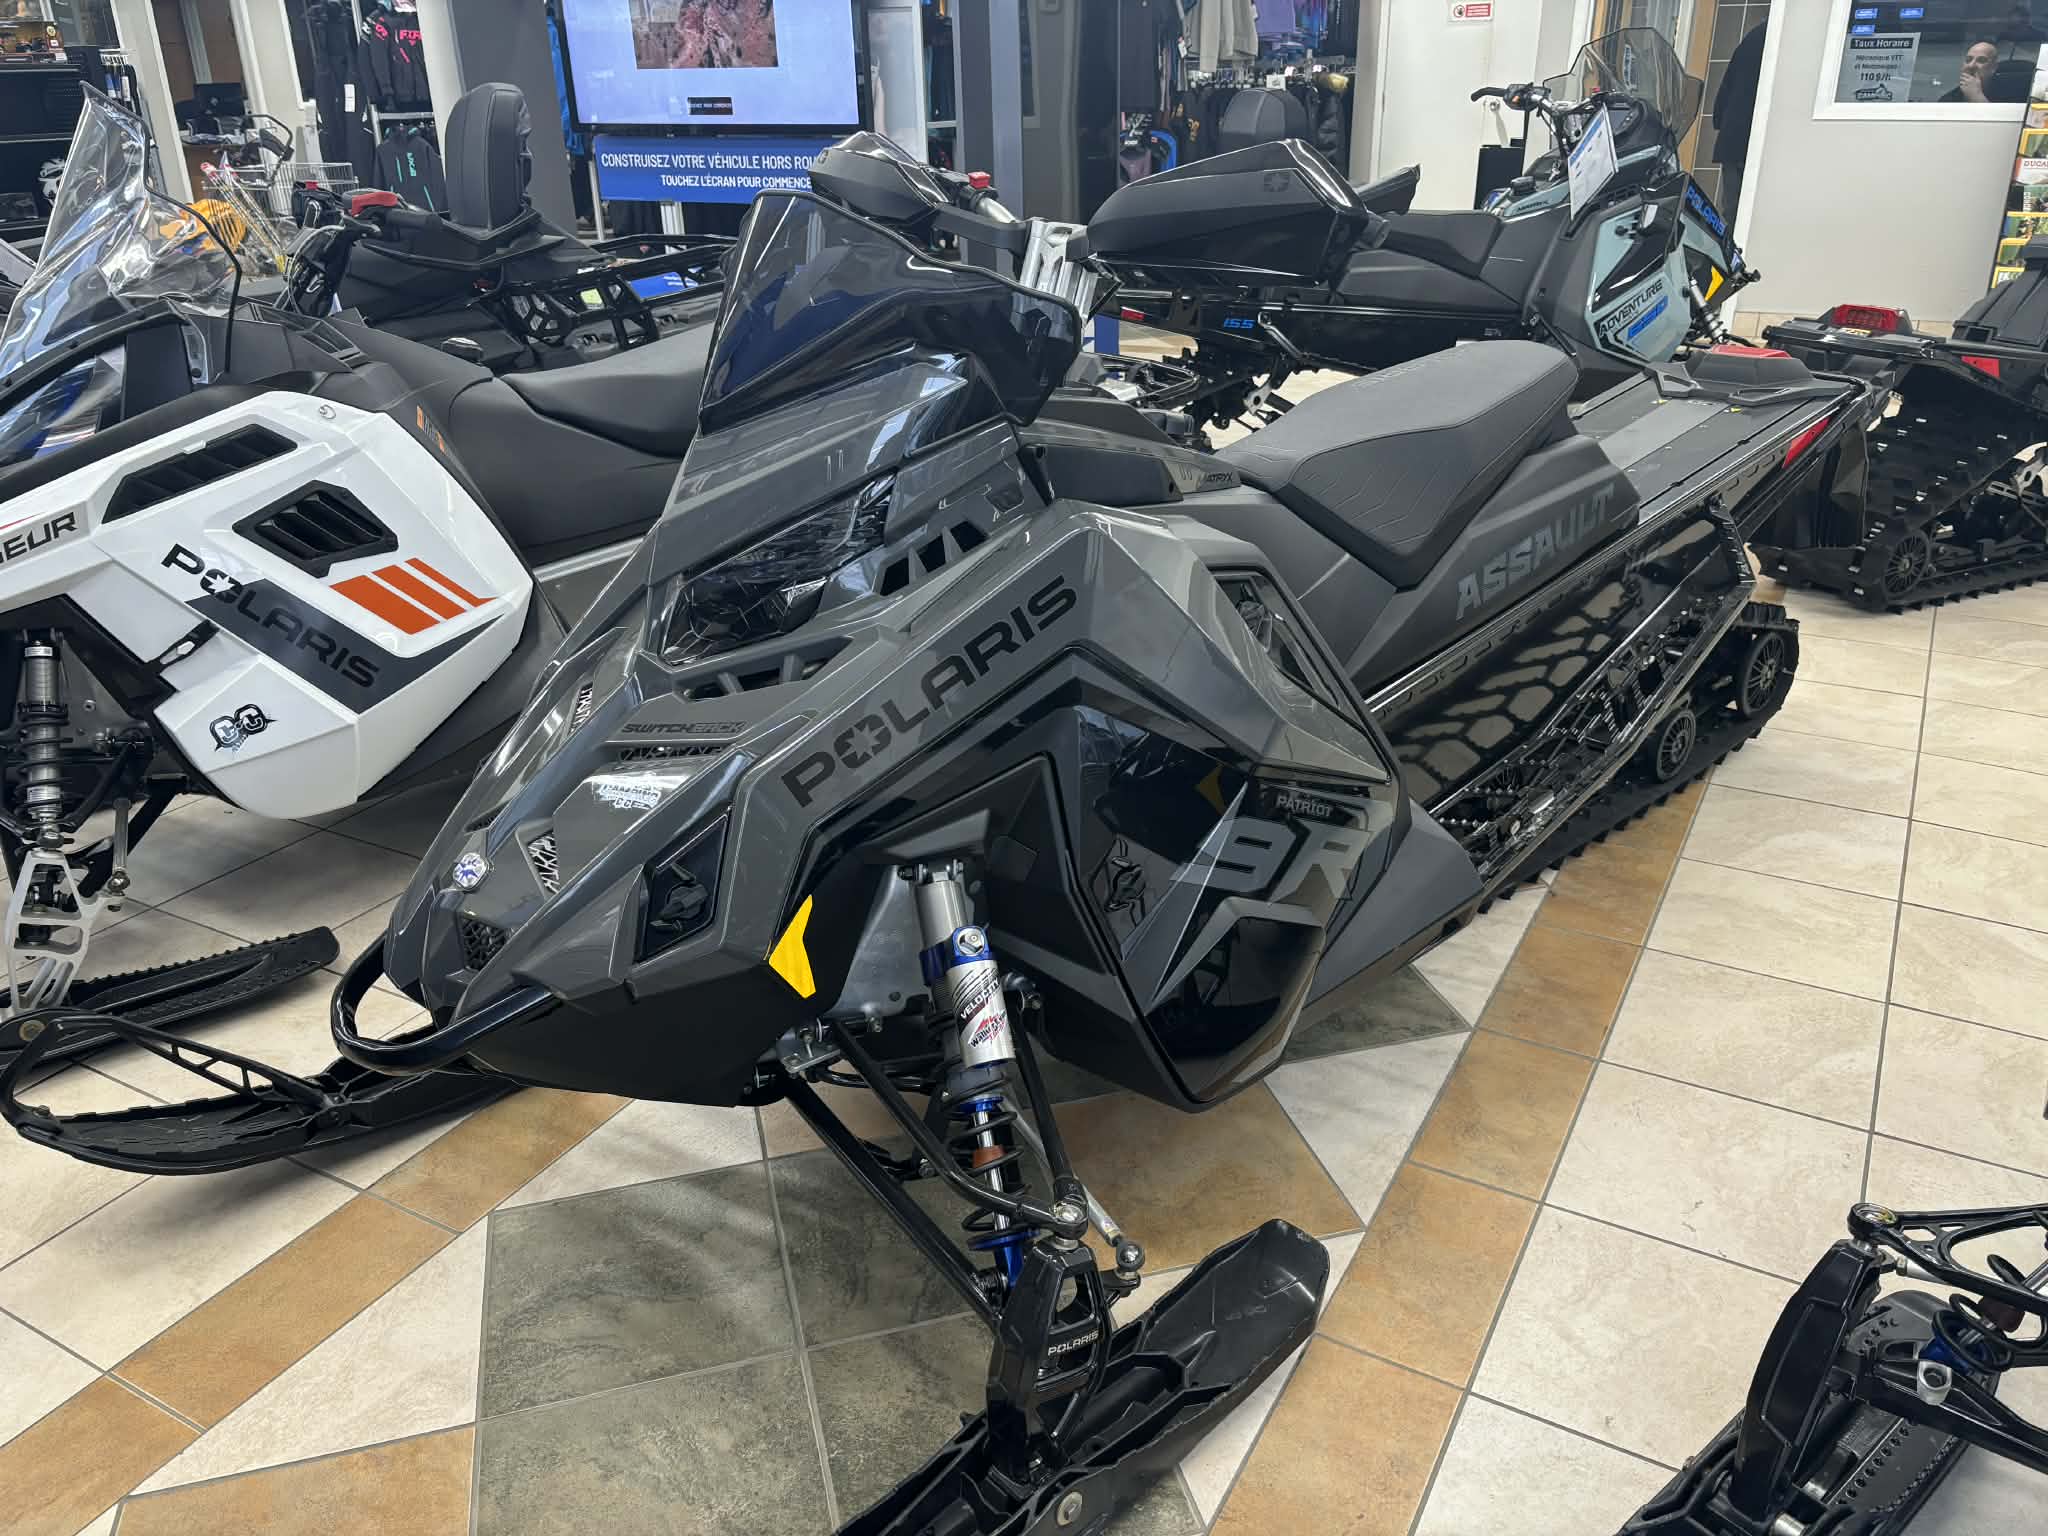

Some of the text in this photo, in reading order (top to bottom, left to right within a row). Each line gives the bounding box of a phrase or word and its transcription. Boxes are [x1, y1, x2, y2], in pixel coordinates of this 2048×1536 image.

[601, 152, 816, 170] CONSTRUISEZ VOTRE VÉHICULE HORS ROU
[661, 174, 700, 187] TOUCHEZ
[737, 175, 762, 188] POUR
[762, 176, 813, 189] COMMENCE
[1685, 184, 1728, 237] POLARIS
[1599, 278, 1664, 338] ADVENTURE
[1456, 481, 1615, 621] ASSAULT
[161, 543, 380, 688] POLARIS
[781, 575, 1077, 808] POLARIS
[1276, 794, 1334, 818] PATRIOT
[960, 976, 1000, 1020] VELOCITY
[1047, 1329, 1100, 1356] POLARIS
